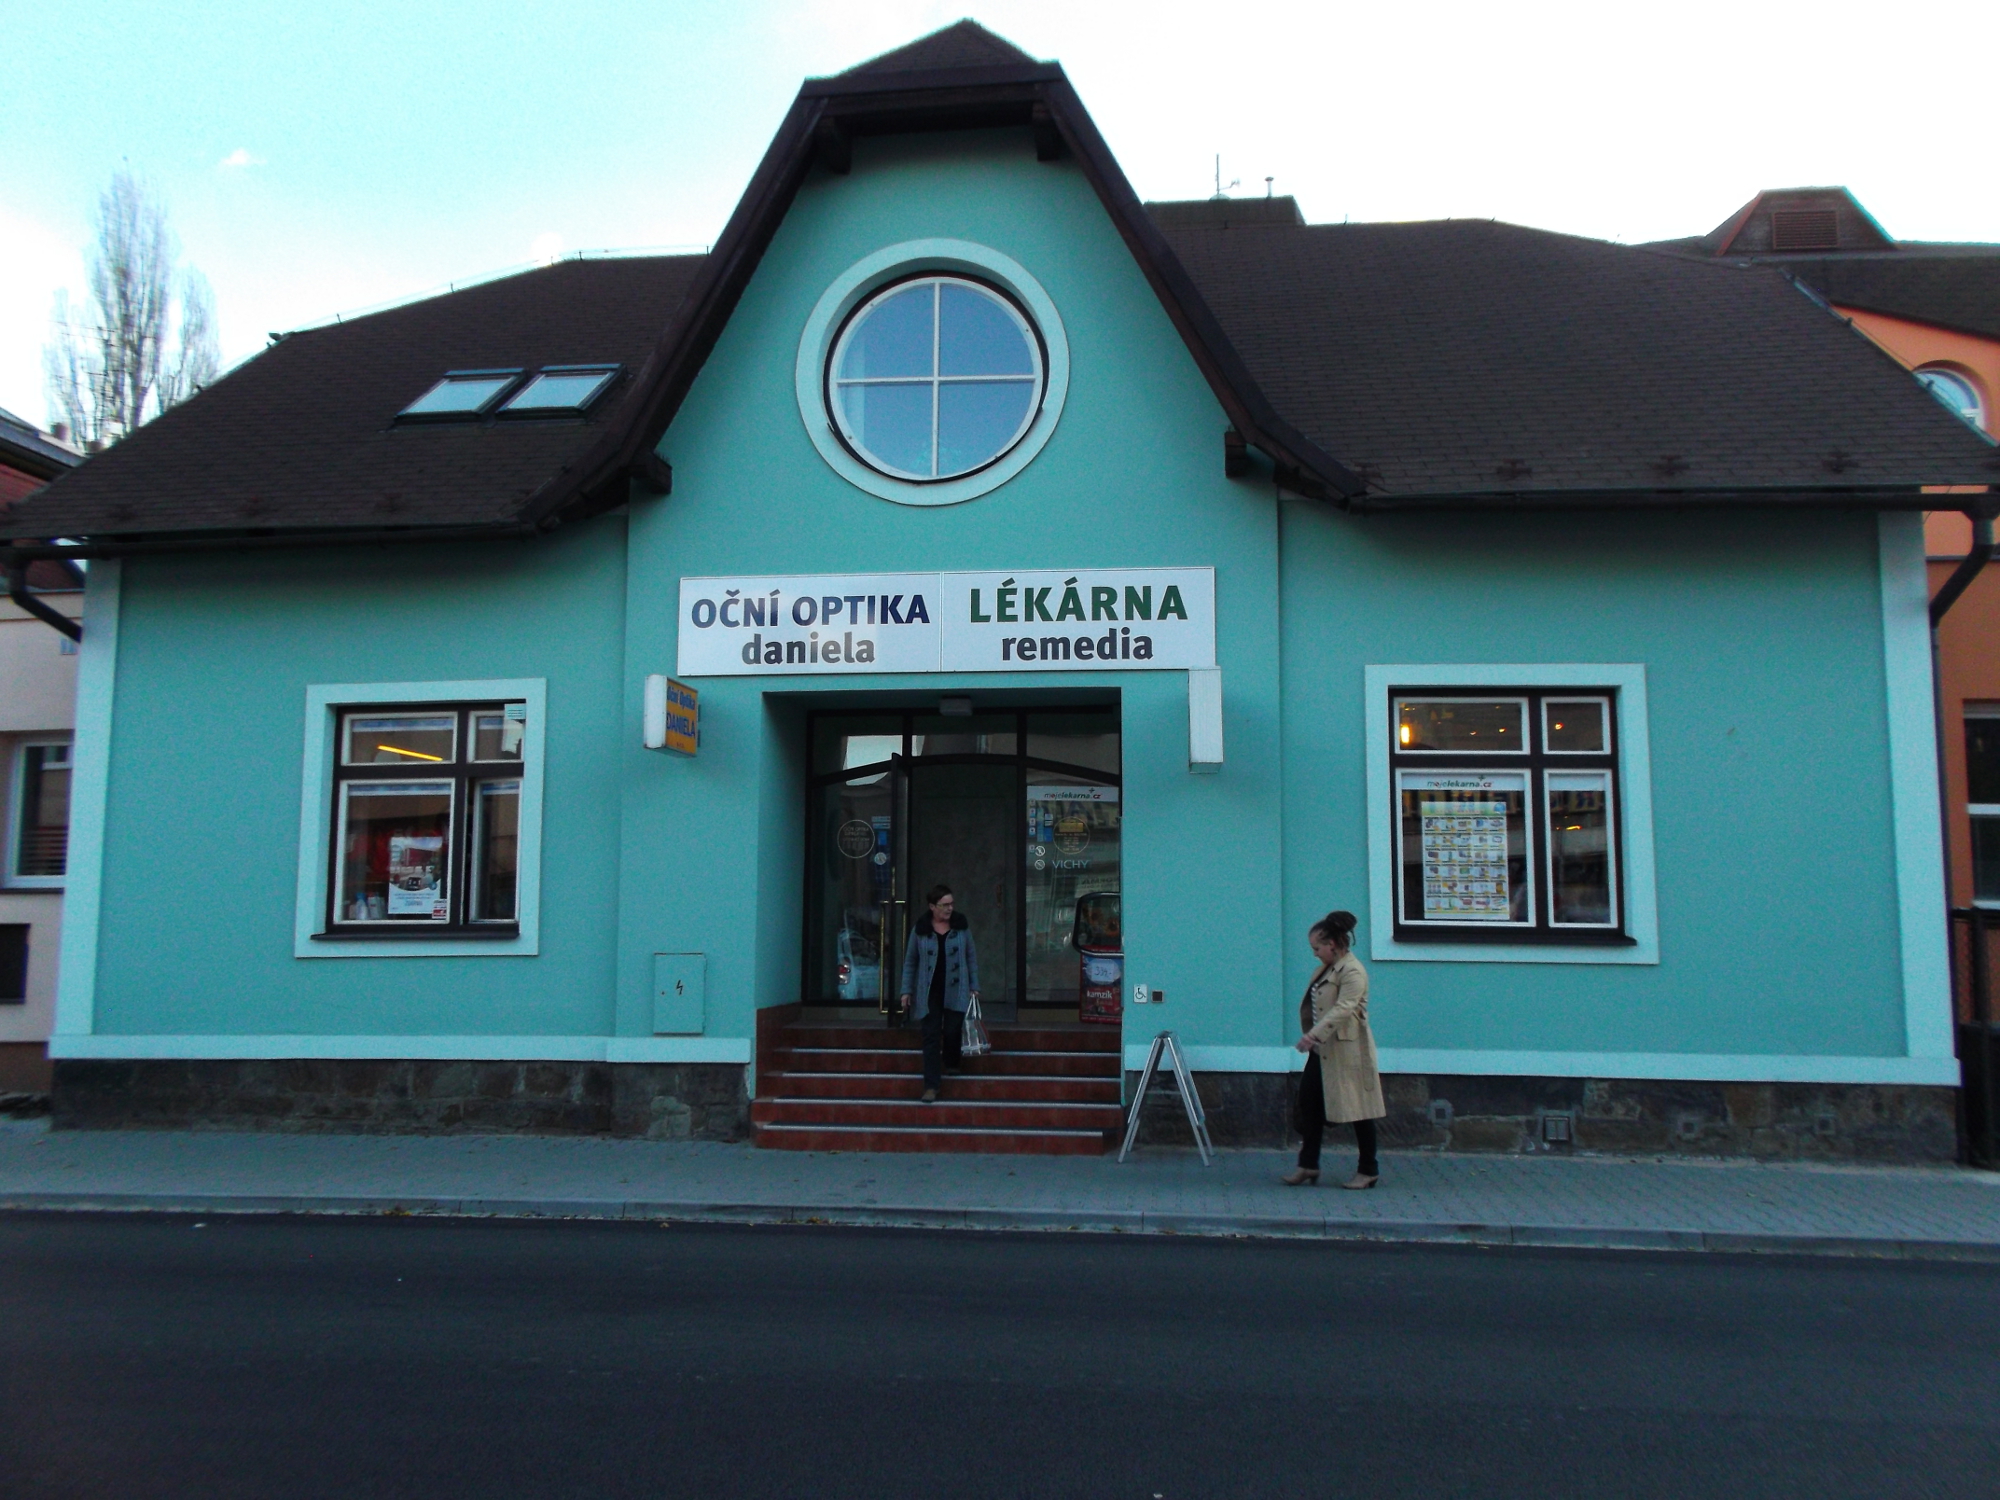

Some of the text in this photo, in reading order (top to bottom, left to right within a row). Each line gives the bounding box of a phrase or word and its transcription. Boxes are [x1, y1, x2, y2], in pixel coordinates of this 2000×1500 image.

[691, 588, 931, 629] OČNÍ OPTIKA
[970, 576, 1188, 623] LÉKÁRNA
[741, 631, 876, 665] daniela
[1002, 626, 1154, 661] remedia
[666, 712, 696, 739] DANIELA
[1052, 859, 1089, 869] VICHY
